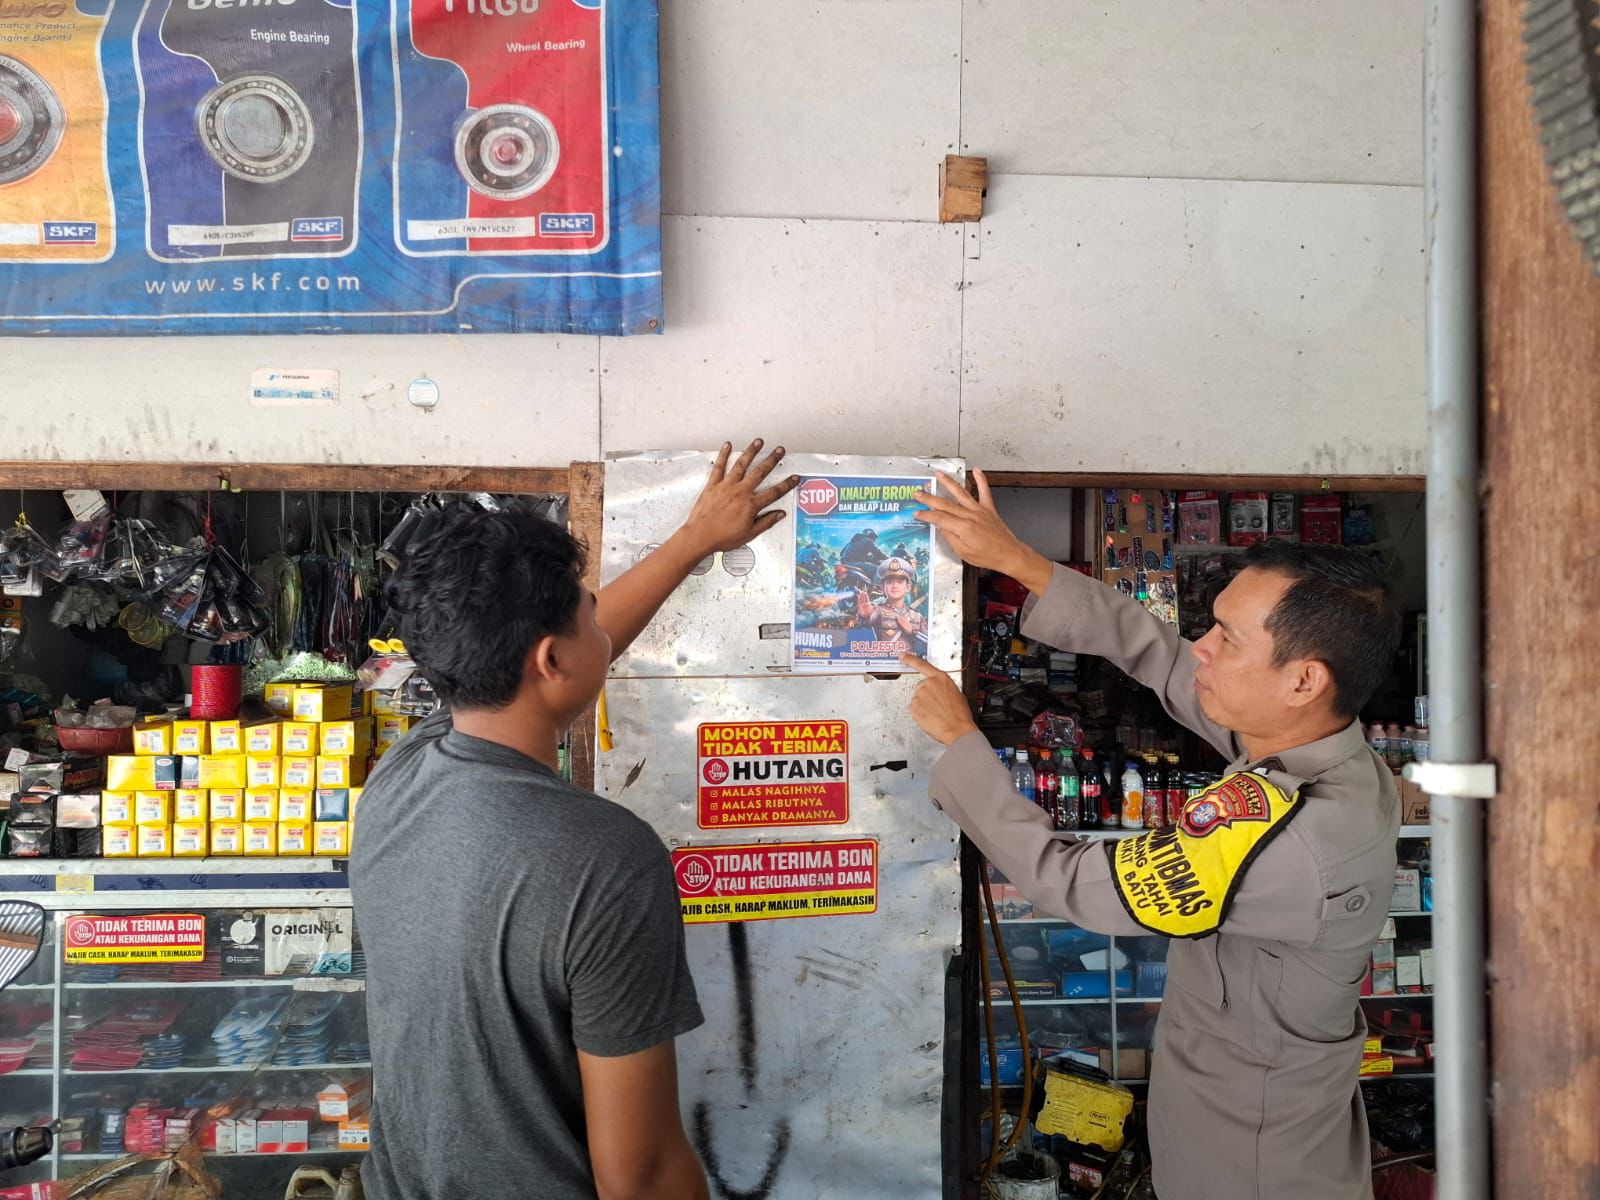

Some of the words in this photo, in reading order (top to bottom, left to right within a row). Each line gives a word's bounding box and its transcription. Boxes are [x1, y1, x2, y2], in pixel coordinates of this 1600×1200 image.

[35, 22, 77, 30] Product
[32, 34, 72, 42] Bearing
[250, 29, 286, 43] Engine
[290, 30, 330, 45] Bearing
[506, 42, 541, 53] Wheel
[544, 39, 586, 50] Bearing
[297, 221, 338, 232] SKF
[546, 217, 589, 229] SKF
[49, 226, 92, 237] SKF
[145, 272, 360, 294] www.skf.com
[800, 488, 835, 504] STOP
[840, 487, 881, 500] KNALPOT
[839, 503, 852, 511] DAN
[853, 503, 879, 512] BALAP
[880, 502, 900, 512] LIAR
[795, 631, 833, 649] HUMAS
[851, 640, 906, 652] POLRESTA
[704, 726, 776, 741] MOHON
[784, 725, 843, 740] MAAF
[703, 741, 761, 756] TIDAK
[770, 739, 843, 754] TERIMA
[733, 758, 844, 780] HUTANG
[722, 787, 762, 797] MALAS
[765, 785, 827, 796] NAGIHNYA
[722, 799, 762, 810] MALAS
[765, 798, 823, 809] RIBUTNYA
[722, 812, 769, 823] BANYAK
[772, 810, 837, 821] DRAMANYA
[713, 854, 764, 873] TIDAK
[767, 851, 833, 871] TERIMA
[838, 848, 873, 868] BON
[689, 874, 710, 884] STOP
[714, 877, 747, 891] ATAU
[750, 872, 834, 889] KEKURANGAN
[837, 870, 872, 885] DANA
[1124, 871, 1151, 909] BATU
[1142, 873, 1173, 916] TAHAI
[682, 904, 702, 915] AJIB
[734, 901, 766, 913] HARAP
[812, 895, 875, 909] TERIMAKASIH
[95, 920, 128, 932] TIDAK
[130, 919, 175, 932] TERIMA
[178, 919, 202, 931] BON
[271, 922, 343, 936] ORIGINL
[95, 934, 117, 944] ATAU
[118, 933, 175, 944] KEKURANGAN
[178, 933, 201, 943] DANA
[66, 951, 87, 959] WAJIB
[108, 950, 130, 959] HARAP
[160, 949, 203, 958] TERIMAKASIH
